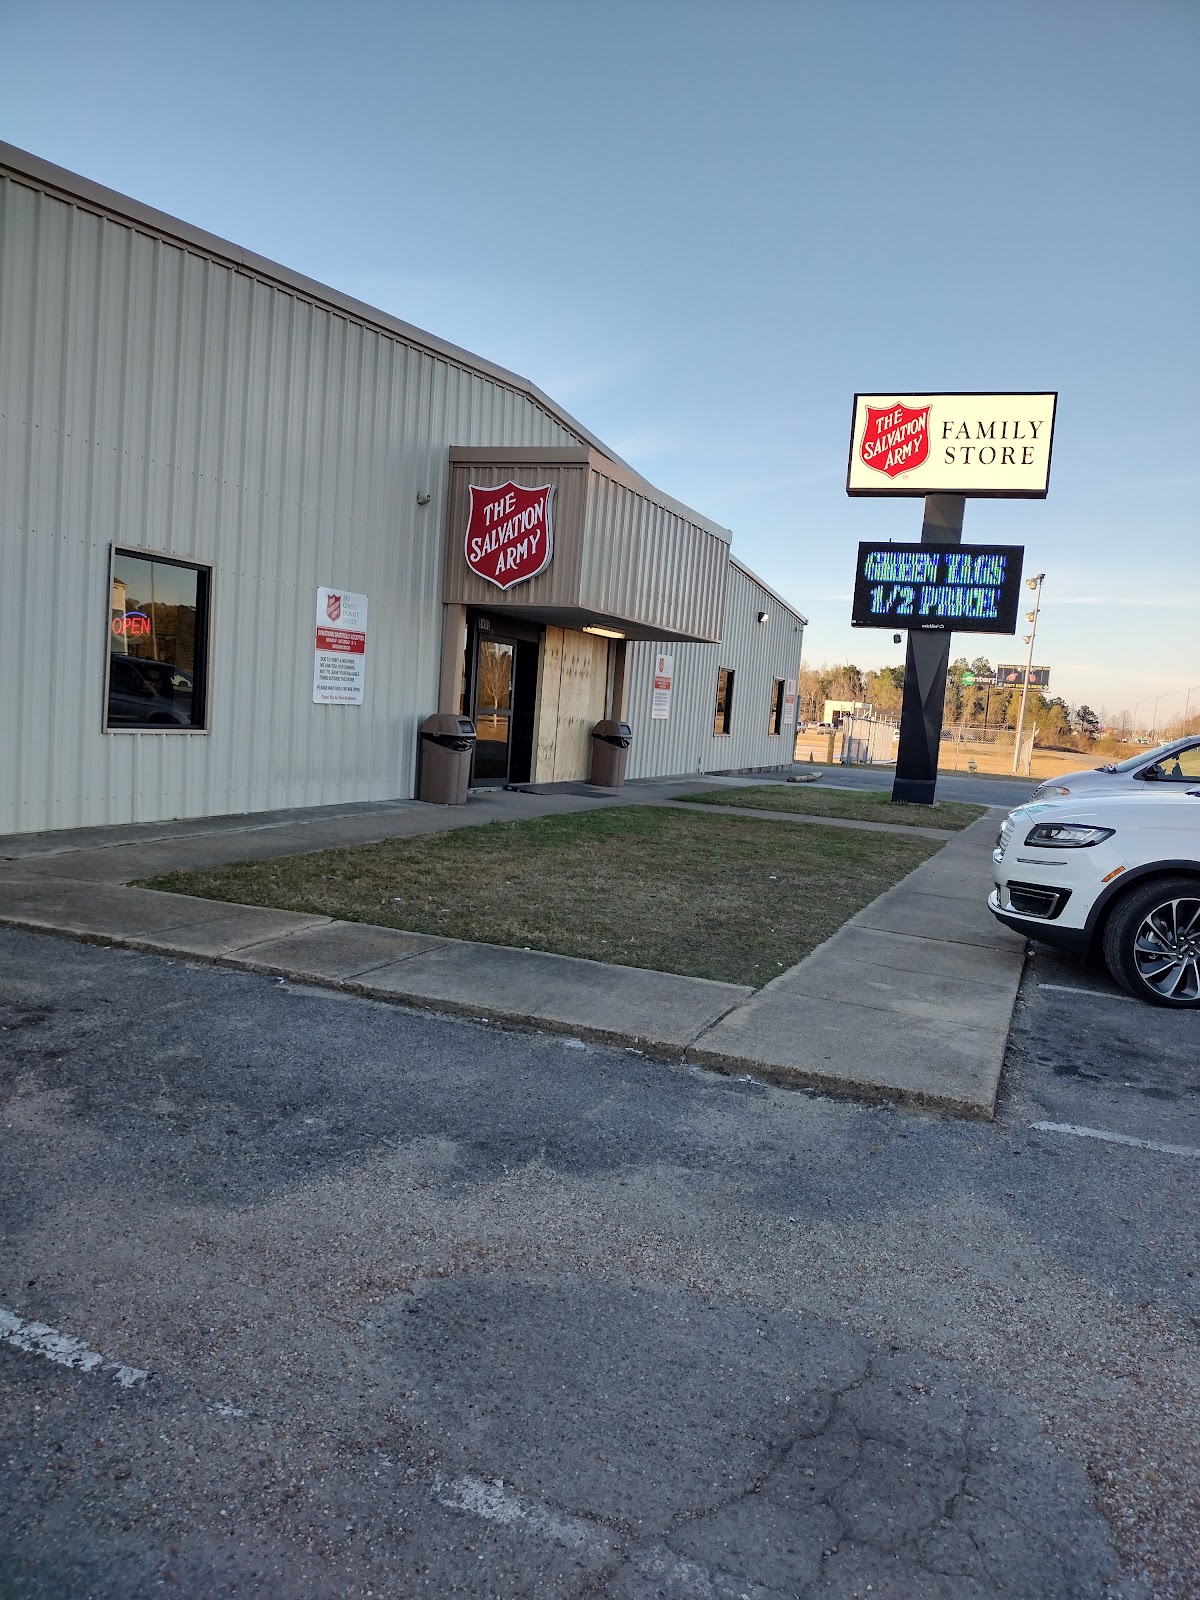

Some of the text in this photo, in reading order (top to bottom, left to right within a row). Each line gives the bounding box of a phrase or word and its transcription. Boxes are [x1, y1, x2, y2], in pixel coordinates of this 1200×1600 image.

[863, 412, 927, 460] SALVATION
[876, 408, 903, 434] THE
[941, 421, 1044, 440] FAMILY
[883, 434, 923, 470] ARMY
[944, 446, 1035, 465] STORE
[483, 491, 517, 527] THE
[470, 497, 544, 562] SALVATION
[495, 529, 541, 576] ARMY
[864, 551, 940, 583] GREEN
[870, 584, 916, 614] 1/2
[111, 617, 151, 635] OPEN
